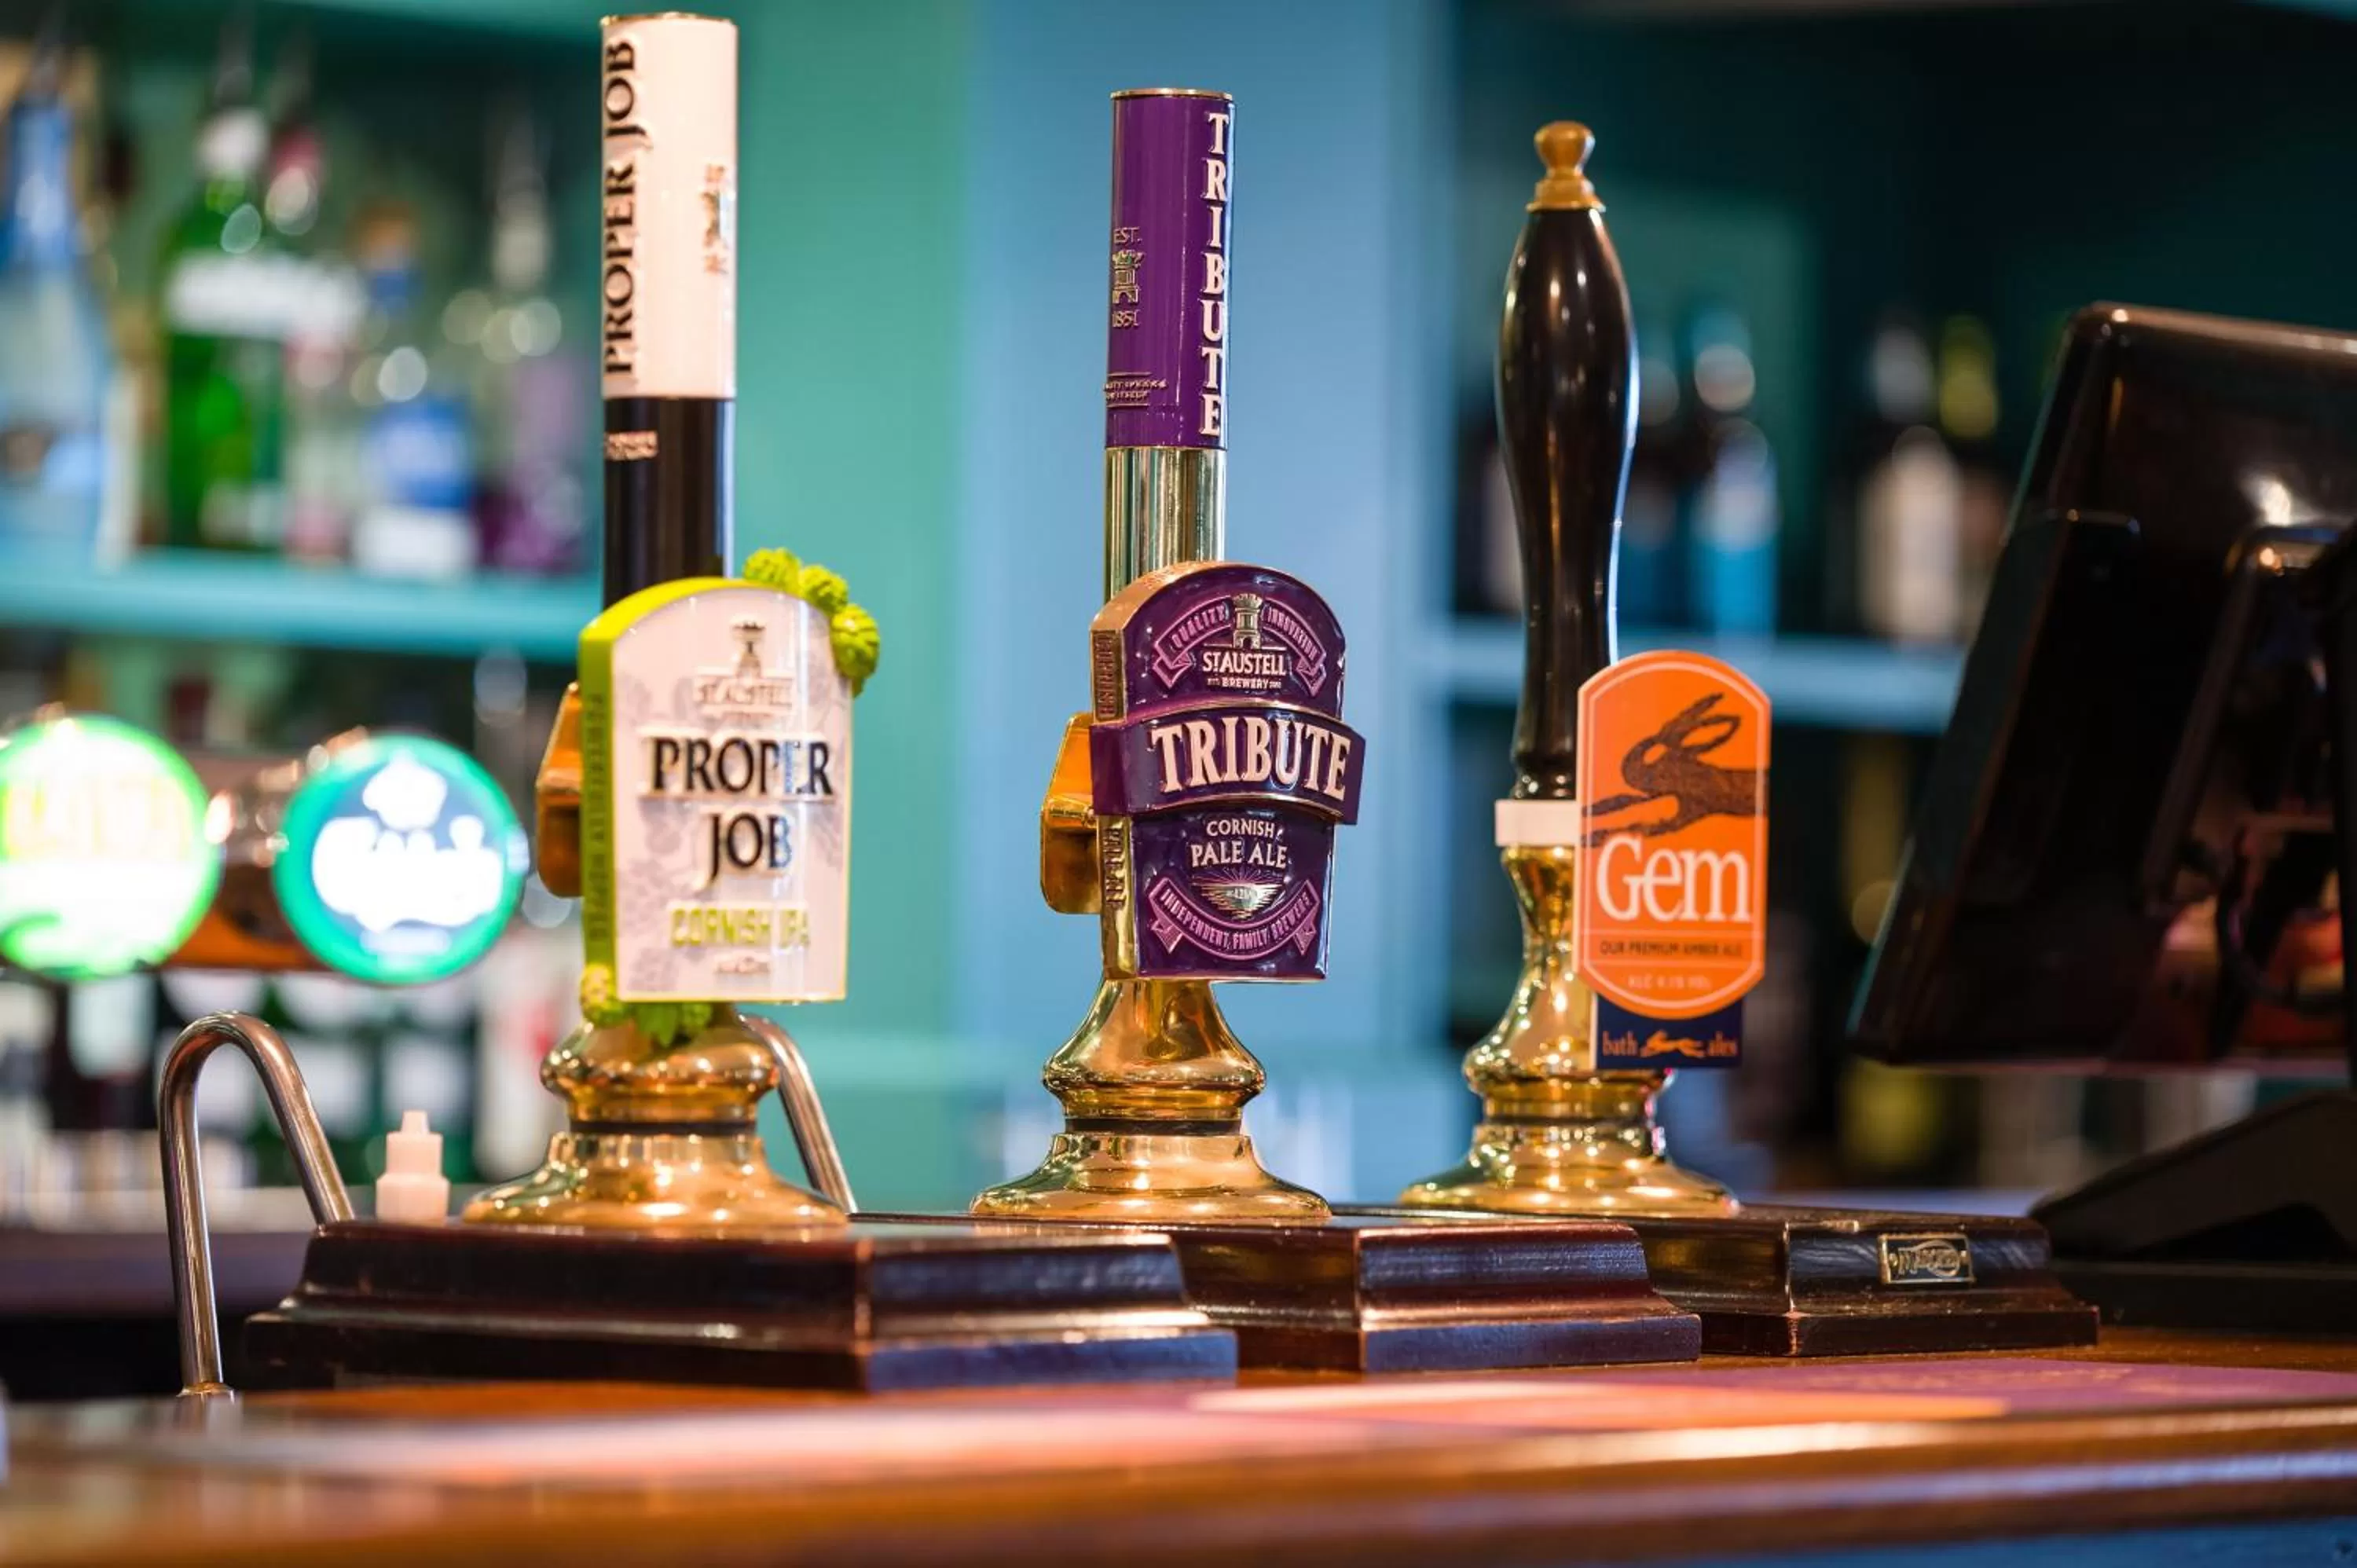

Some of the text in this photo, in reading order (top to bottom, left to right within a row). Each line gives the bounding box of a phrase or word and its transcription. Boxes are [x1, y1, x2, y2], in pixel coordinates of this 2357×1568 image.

[605, 39, 647, 375] PROPER JOB
[1200, 112, 1229, 437] TRIBUTE
[1171, 604, 1226, 650] QUALITY
[1222, 677, 1269, 689] BREWERY
[651, 736, 834, 795] PROPER
[1150, 714, 1352, 802] TRIBUTE
[709, 812, 793, 881] JOB
[1190, 841, 1288, 869] PALE ALE
[1206, 819, 1275, 838] CORNISH
[1596, 833, 1754, 922] Gem
[672, 907, 772, 948] CORNISH
